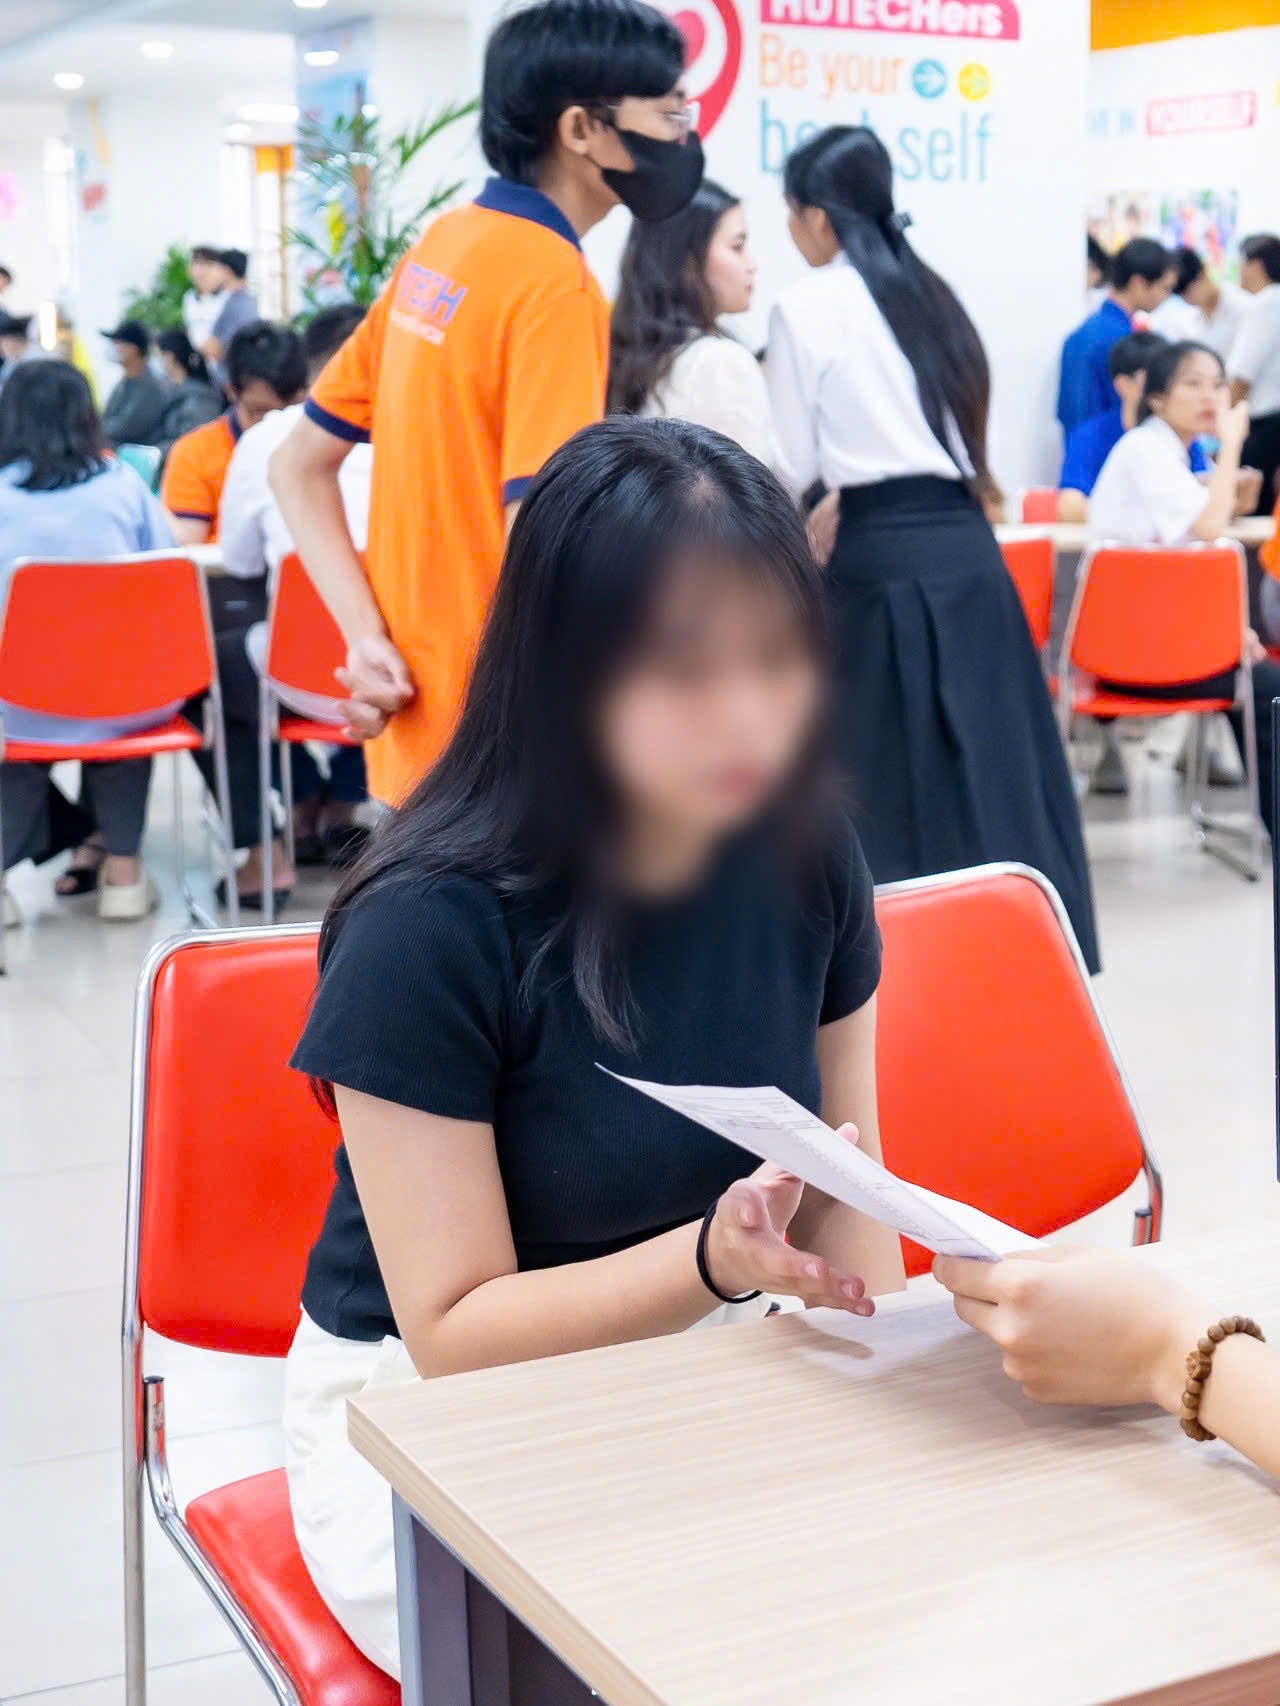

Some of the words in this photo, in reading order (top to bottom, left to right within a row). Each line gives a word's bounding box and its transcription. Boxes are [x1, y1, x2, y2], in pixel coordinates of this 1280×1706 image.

[759, 32, 808, 89] Be
[820, 52, 905, 102] your
[898, 110, 992, 182] self
